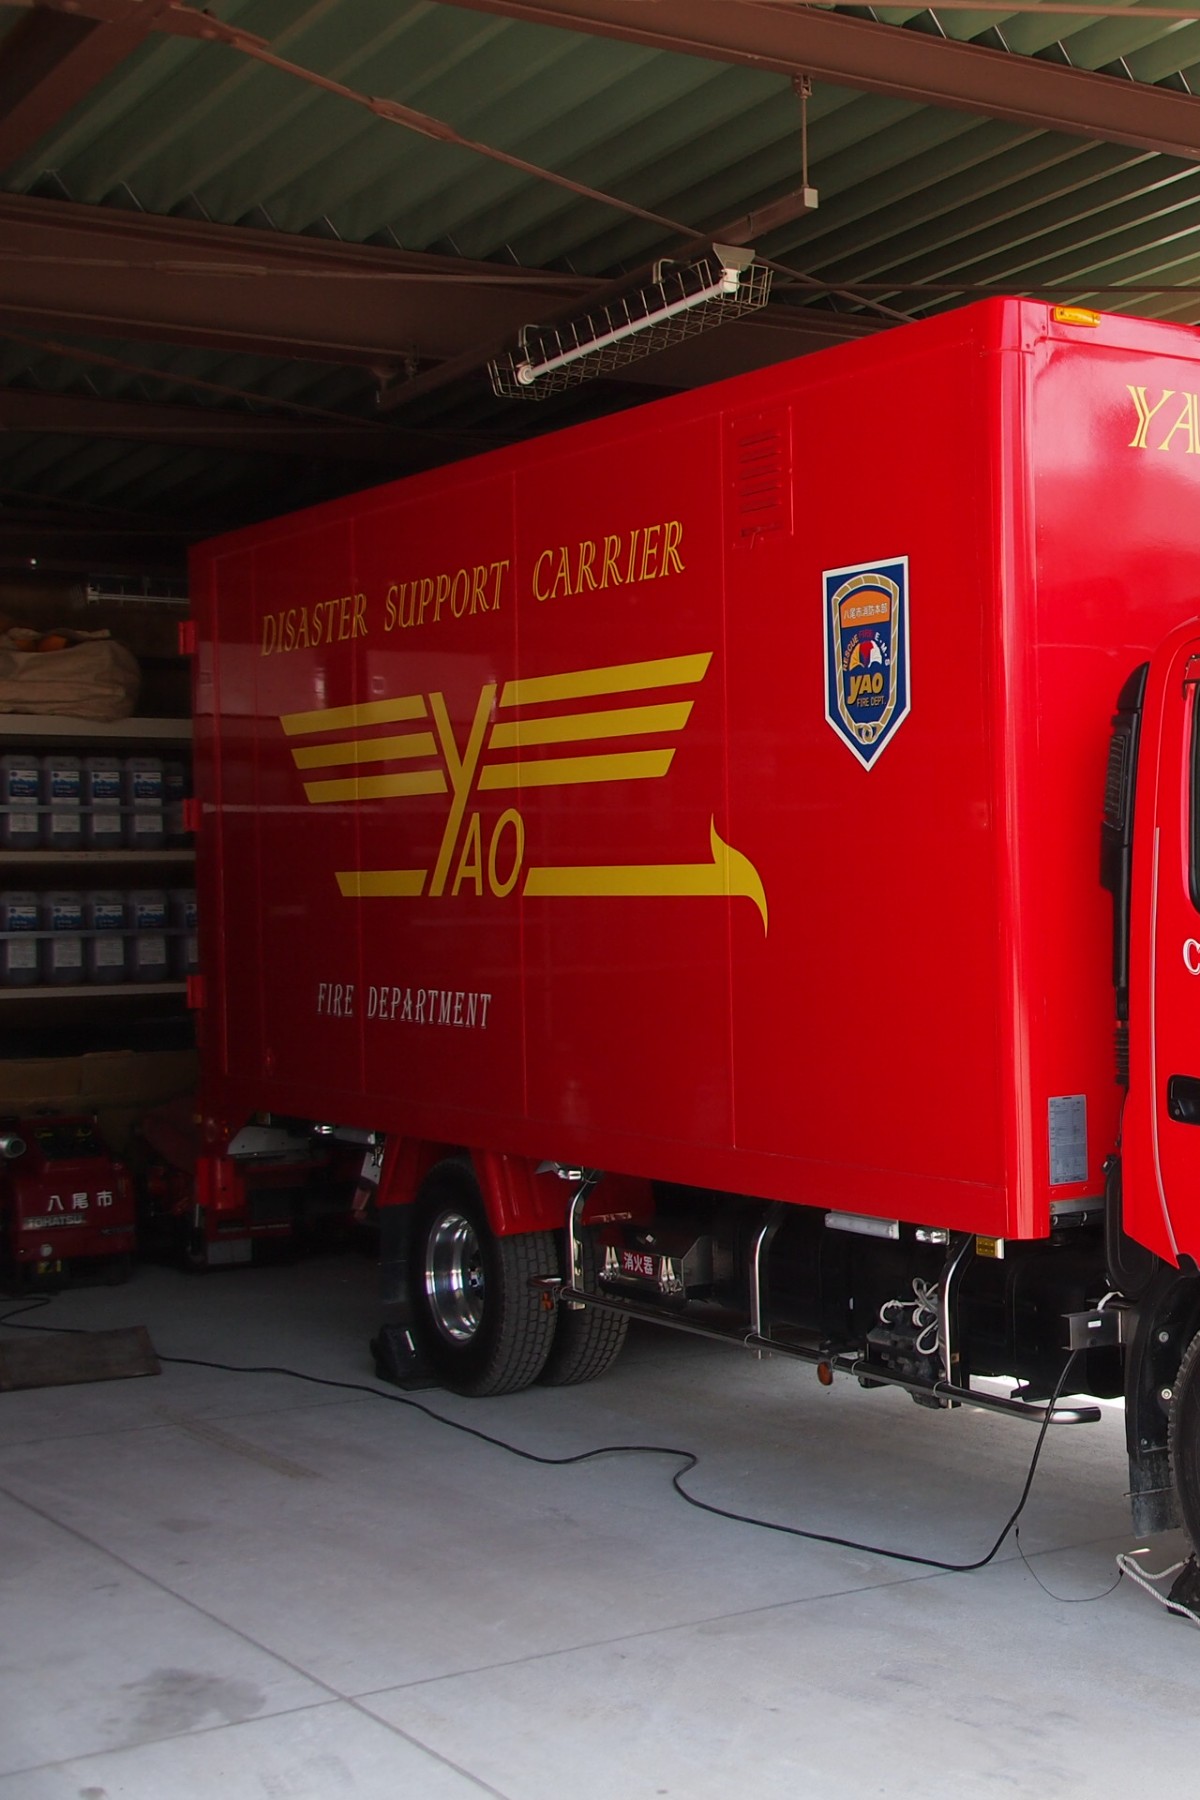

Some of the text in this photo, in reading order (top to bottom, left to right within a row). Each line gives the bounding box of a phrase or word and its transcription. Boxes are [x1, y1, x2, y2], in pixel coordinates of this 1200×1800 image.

[261, 520, 686, 657] DISASTER SUPPORT CARRIER
[856, 696, 870, 708] FIRE
[428, 683, 525, 897] YAO
[317, 982, 492, 1029] FIRE DEPARTMENT
[47, 1190, 113, 1212] 八尾市
[27, 1214, 83, 1229] TOHATSU
[624, 1252, 653, 1275] 消火器
